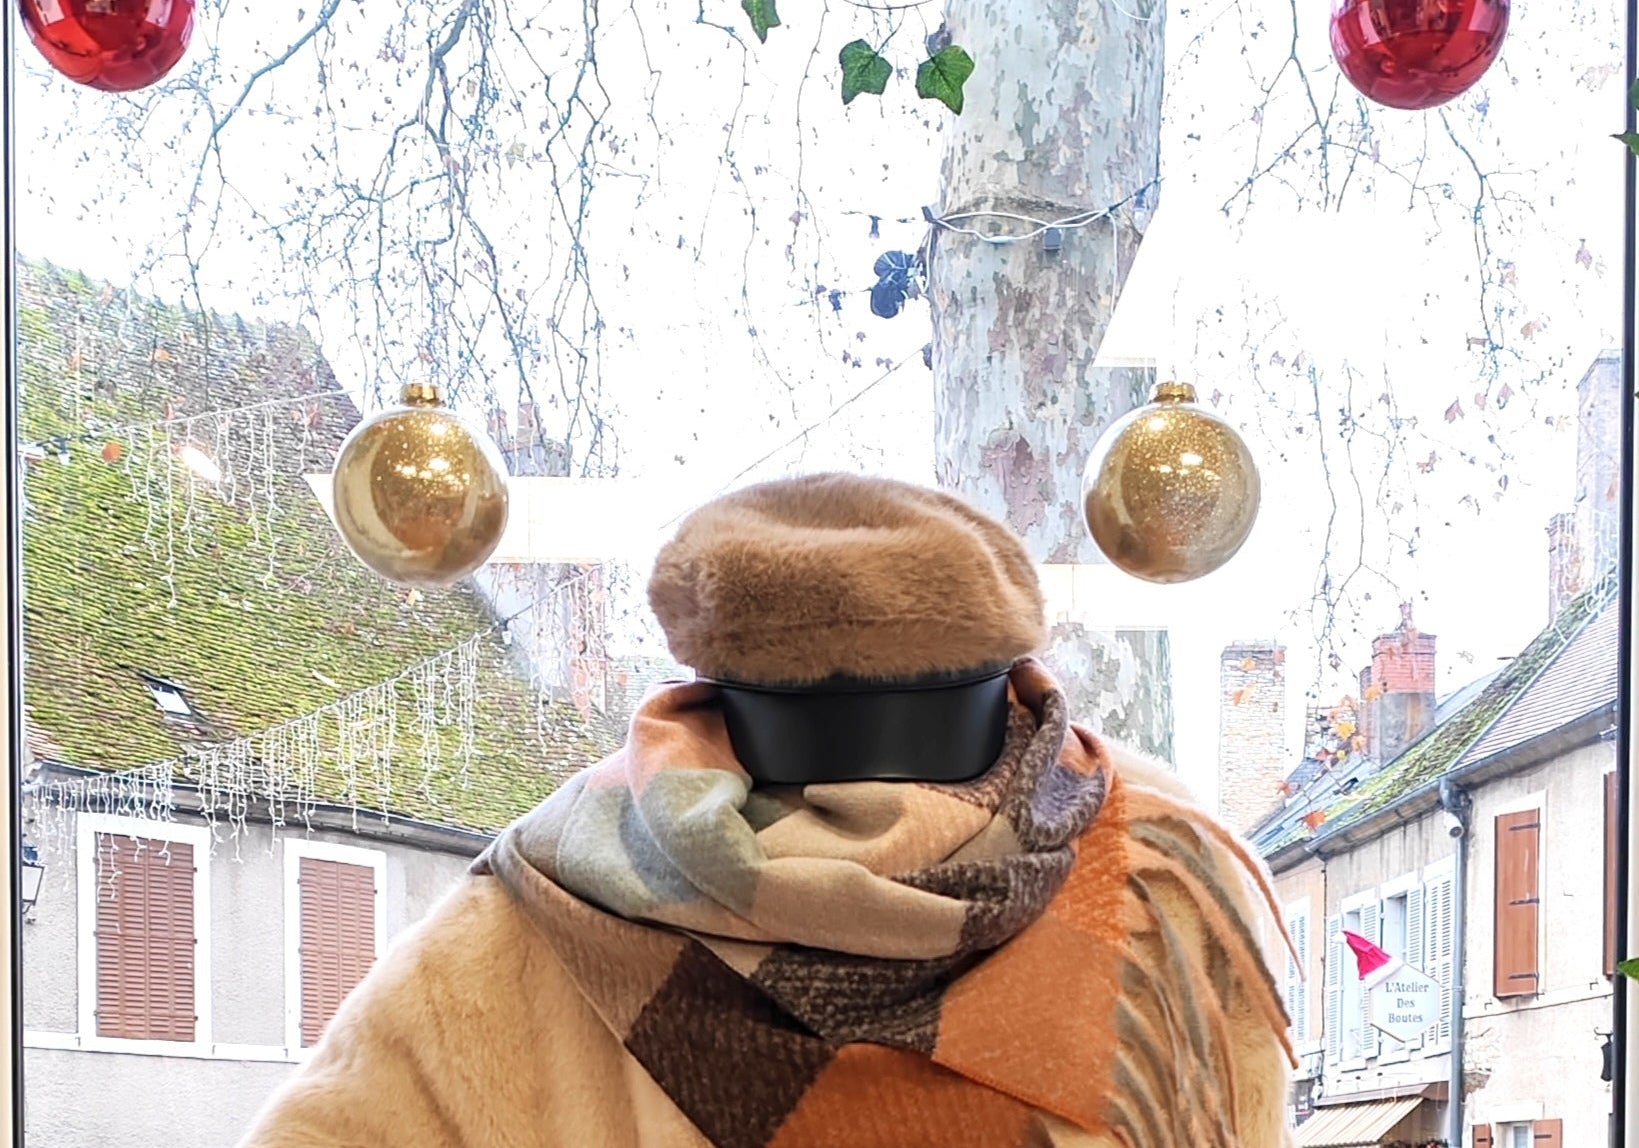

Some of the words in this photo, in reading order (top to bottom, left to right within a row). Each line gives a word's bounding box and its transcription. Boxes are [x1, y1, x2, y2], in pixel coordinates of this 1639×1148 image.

[1385, 982, 1429, 992] L'Atelier
[1397, 998, 1415, 1008] Des
[1388, 1013, 1423, 1023] Boutes
